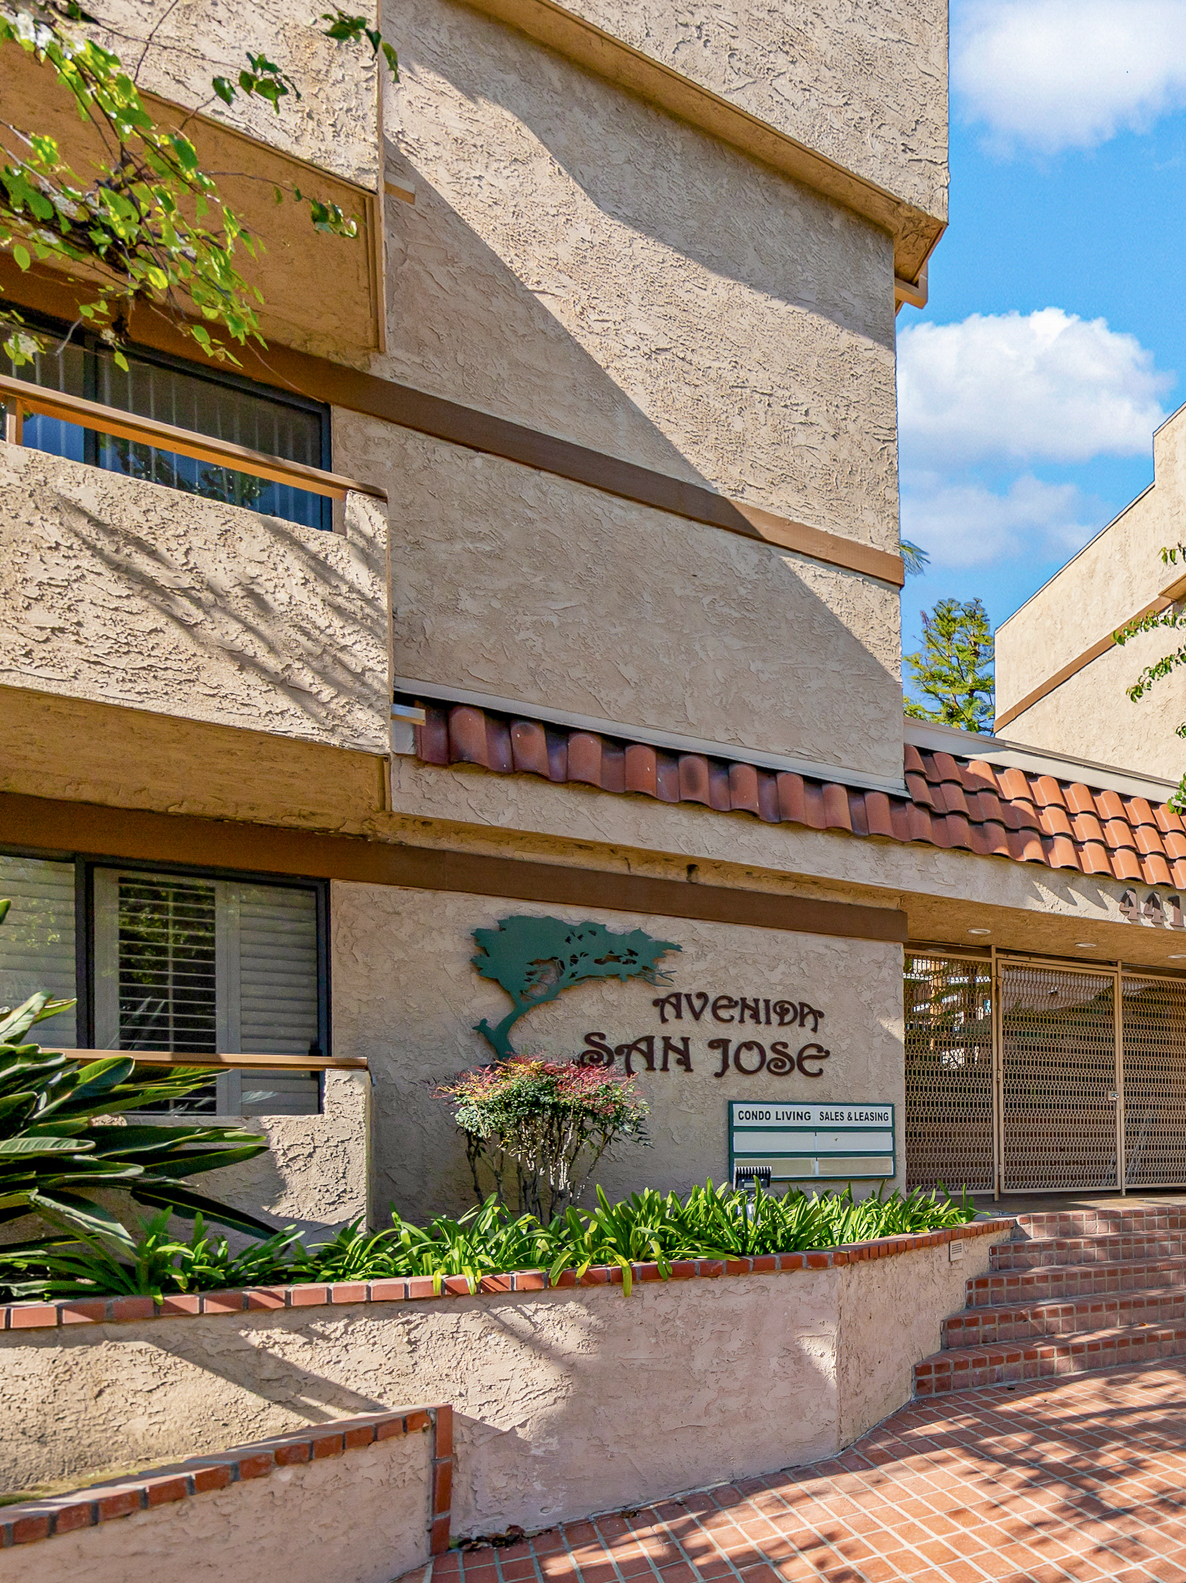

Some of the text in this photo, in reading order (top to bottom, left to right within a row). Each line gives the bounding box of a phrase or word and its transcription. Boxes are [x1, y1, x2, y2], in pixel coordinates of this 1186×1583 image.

[1119, 887, 1185, 927] 441
[652, 991, 825, 1033] AVENIDA
[580, 1031, 831, 1078] SAN JOSE
[737, 1110, 772, 1121] CONDO
[775, 1110, 812, 1121] LIVING
[819, 1111, 845, 1121] SALES
[854, 1111, 889, 1122] LEASING
